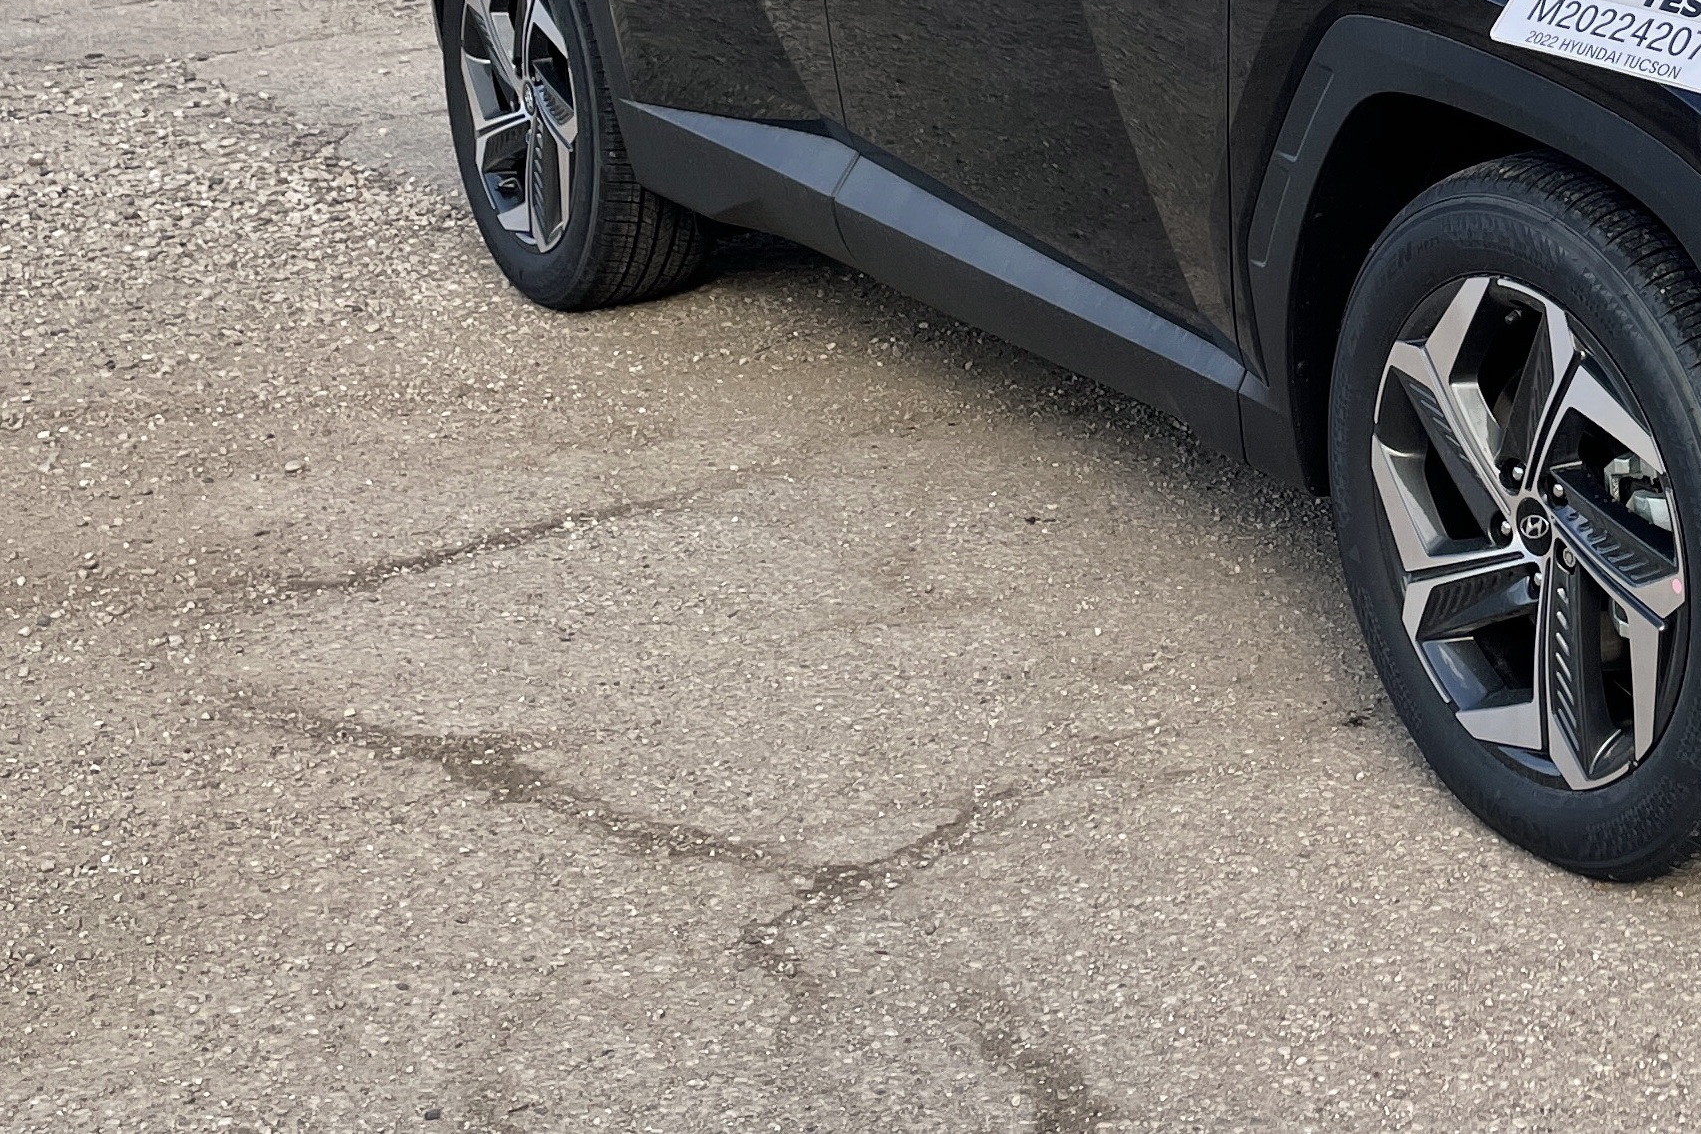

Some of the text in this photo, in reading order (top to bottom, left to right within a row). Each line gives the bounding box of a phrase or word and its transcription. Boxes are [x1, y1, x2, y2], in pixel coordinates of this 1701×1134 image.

[1525, 30, 1683, 80] 2022 HYUNDAI TUCSON
